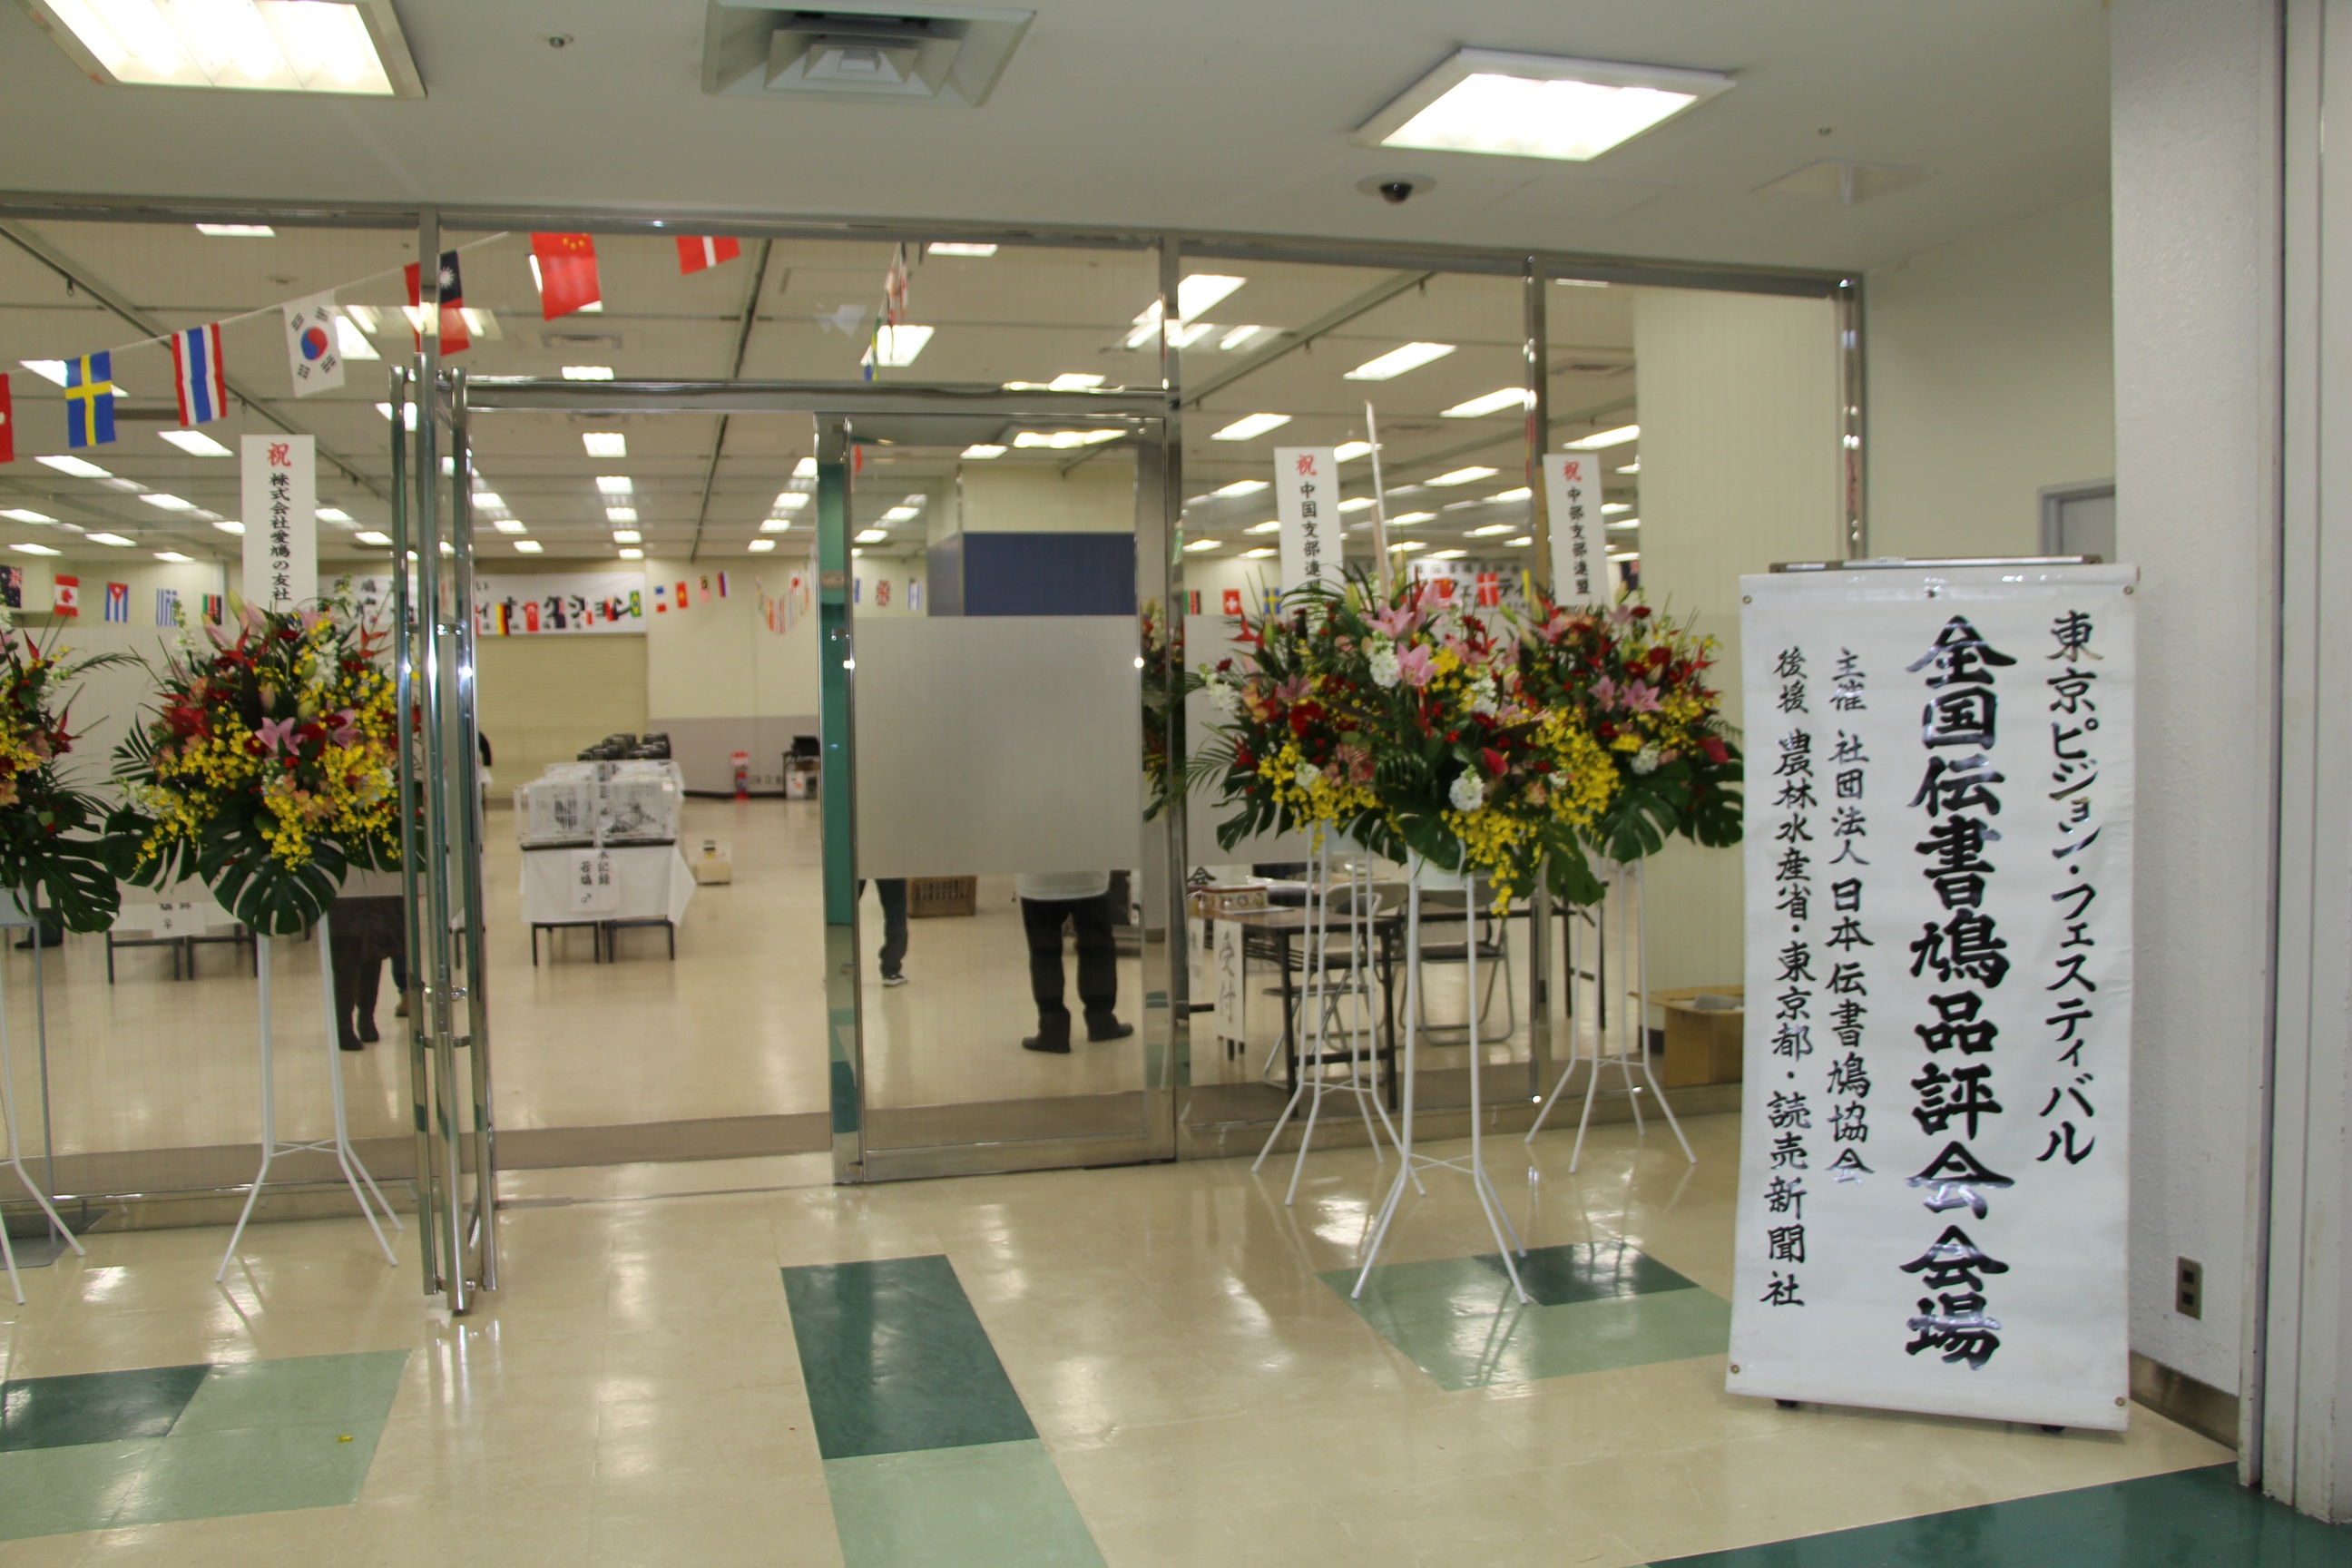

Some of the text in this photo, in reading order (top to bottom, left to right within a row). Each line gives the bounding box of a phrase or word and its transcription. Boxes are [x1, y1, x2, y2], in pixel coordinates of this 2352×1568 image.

[267, 442, 291, 468] 祝
[1297, 454, 1318, 476] 祝
[1563, 461, 1583, 483] 祝
[270, 473, 291, 601] 株式会社愛鳩の友社
[1567, 486, 1591, 594] 中部支部連盟
[1773, 646, 1808, 713] 後援
[1829, 648, 1867, 711] 主催
[2036, 610, 2103, 1165] 東京ピジョン・フェスティバル
[1899, 615, 2017, 1370] 全国伝書鳩品評会会場
